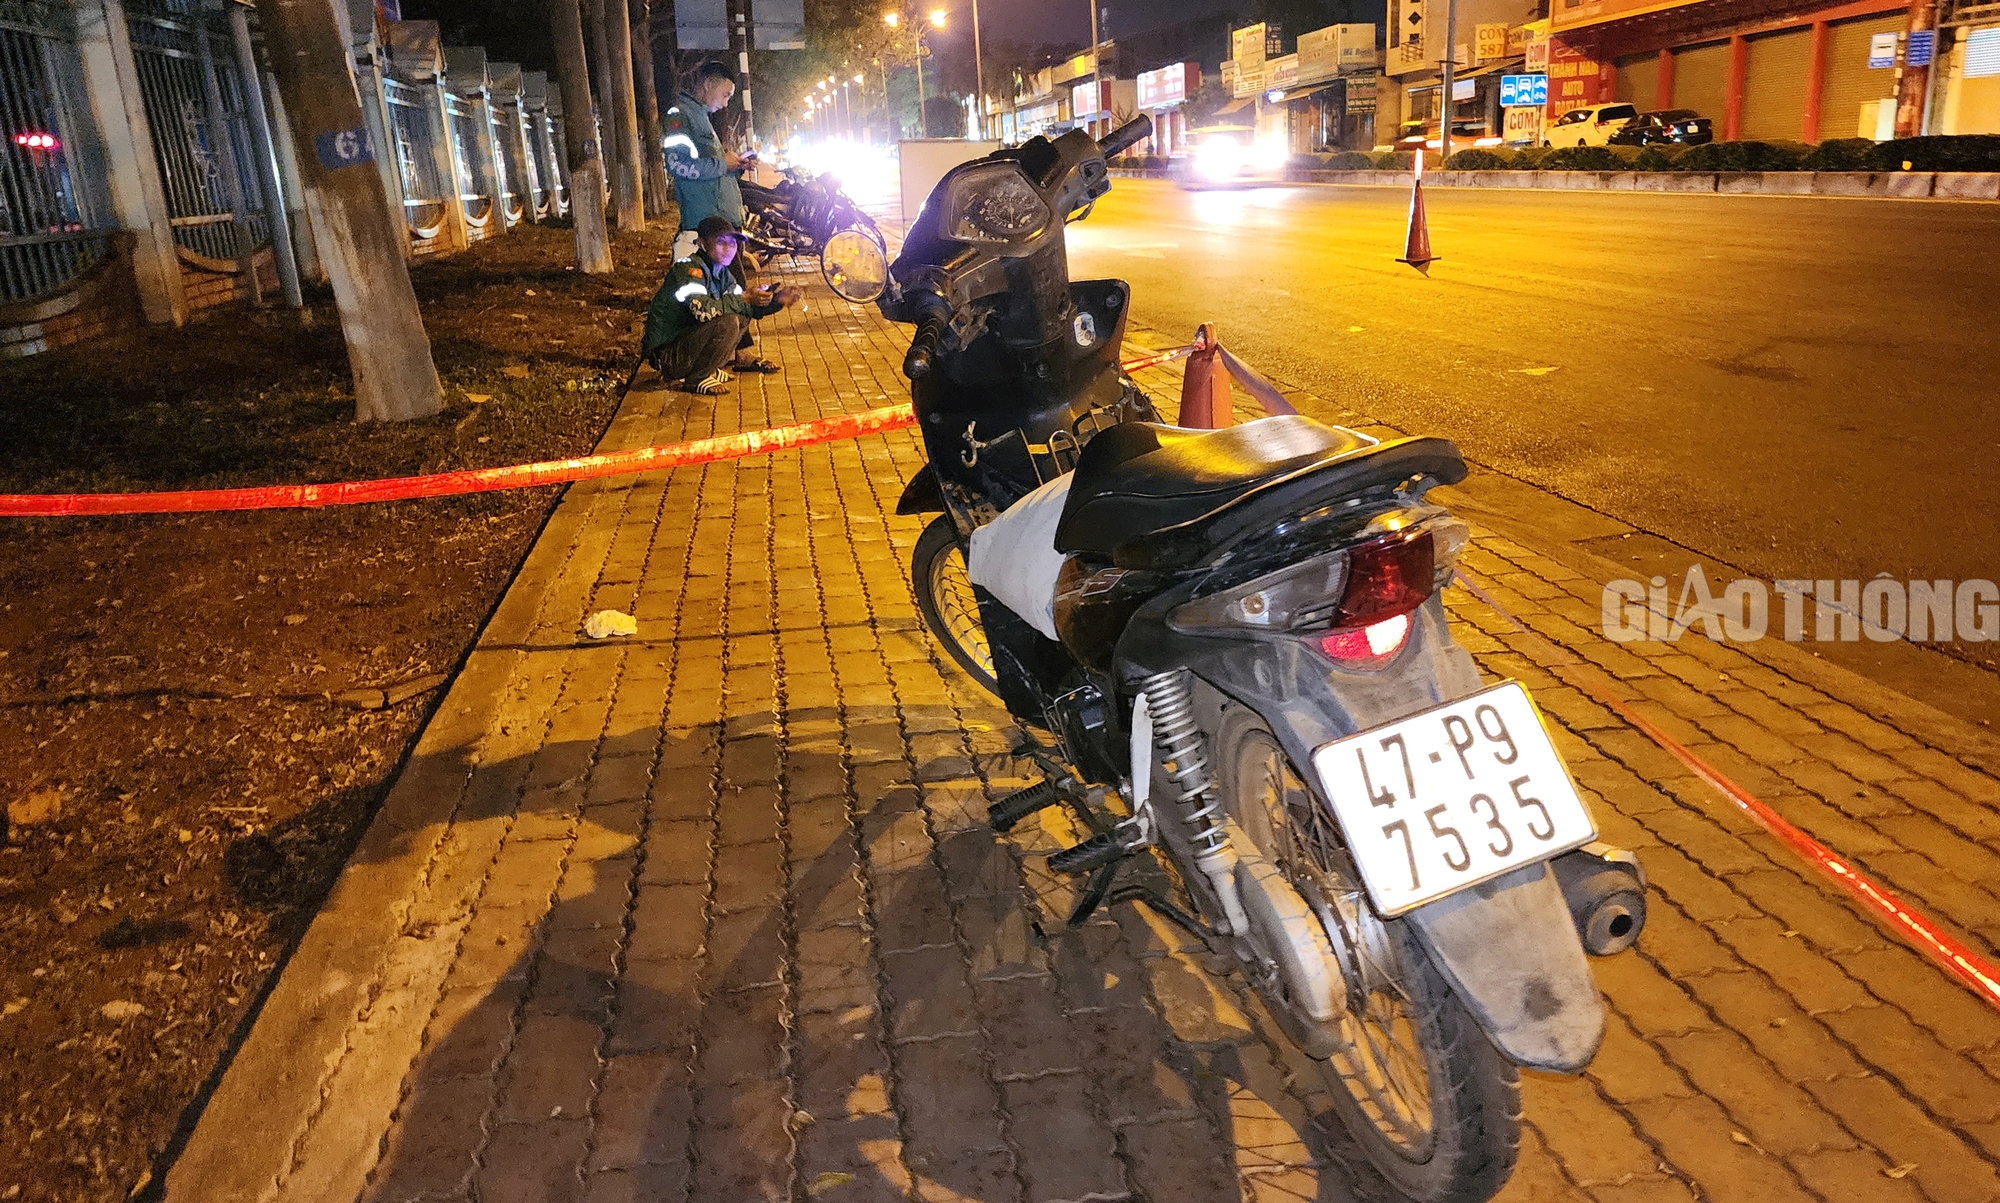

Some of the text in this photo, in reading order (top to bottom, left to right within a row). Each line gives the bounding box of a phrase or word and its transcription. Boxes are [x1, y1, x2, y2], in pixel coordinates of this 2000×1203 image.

[1479, 43, 1503, 56] 587
[1561, 80, 1584, 97] AUTO
[667, 152, 701, 180] Grab
[1380, 774, 1556, 892] 7535
